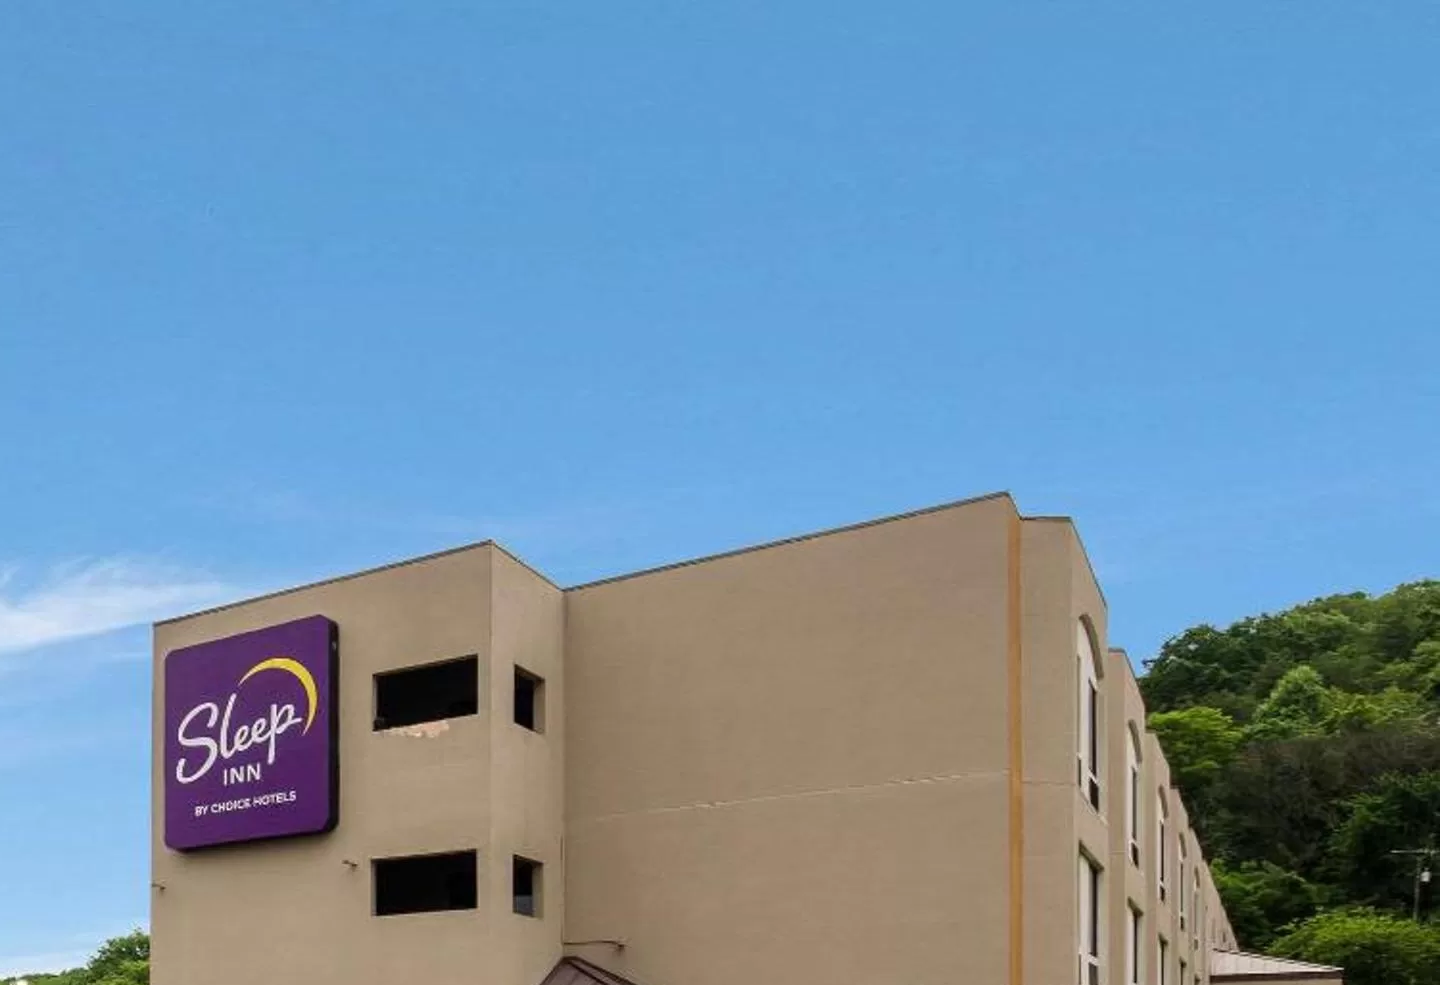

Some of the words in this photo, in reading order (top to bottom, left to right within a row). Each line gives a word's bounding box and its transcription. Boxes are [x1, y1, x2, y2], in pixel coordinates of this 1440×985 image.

[176, 693, 302, 784] Sleep
[223, 763, 261, 786] INN
[195, 804, 210, 817] BY
[210, 797, 252, 813] CHOICE
[252, 790, 297, 807] HOTELS
